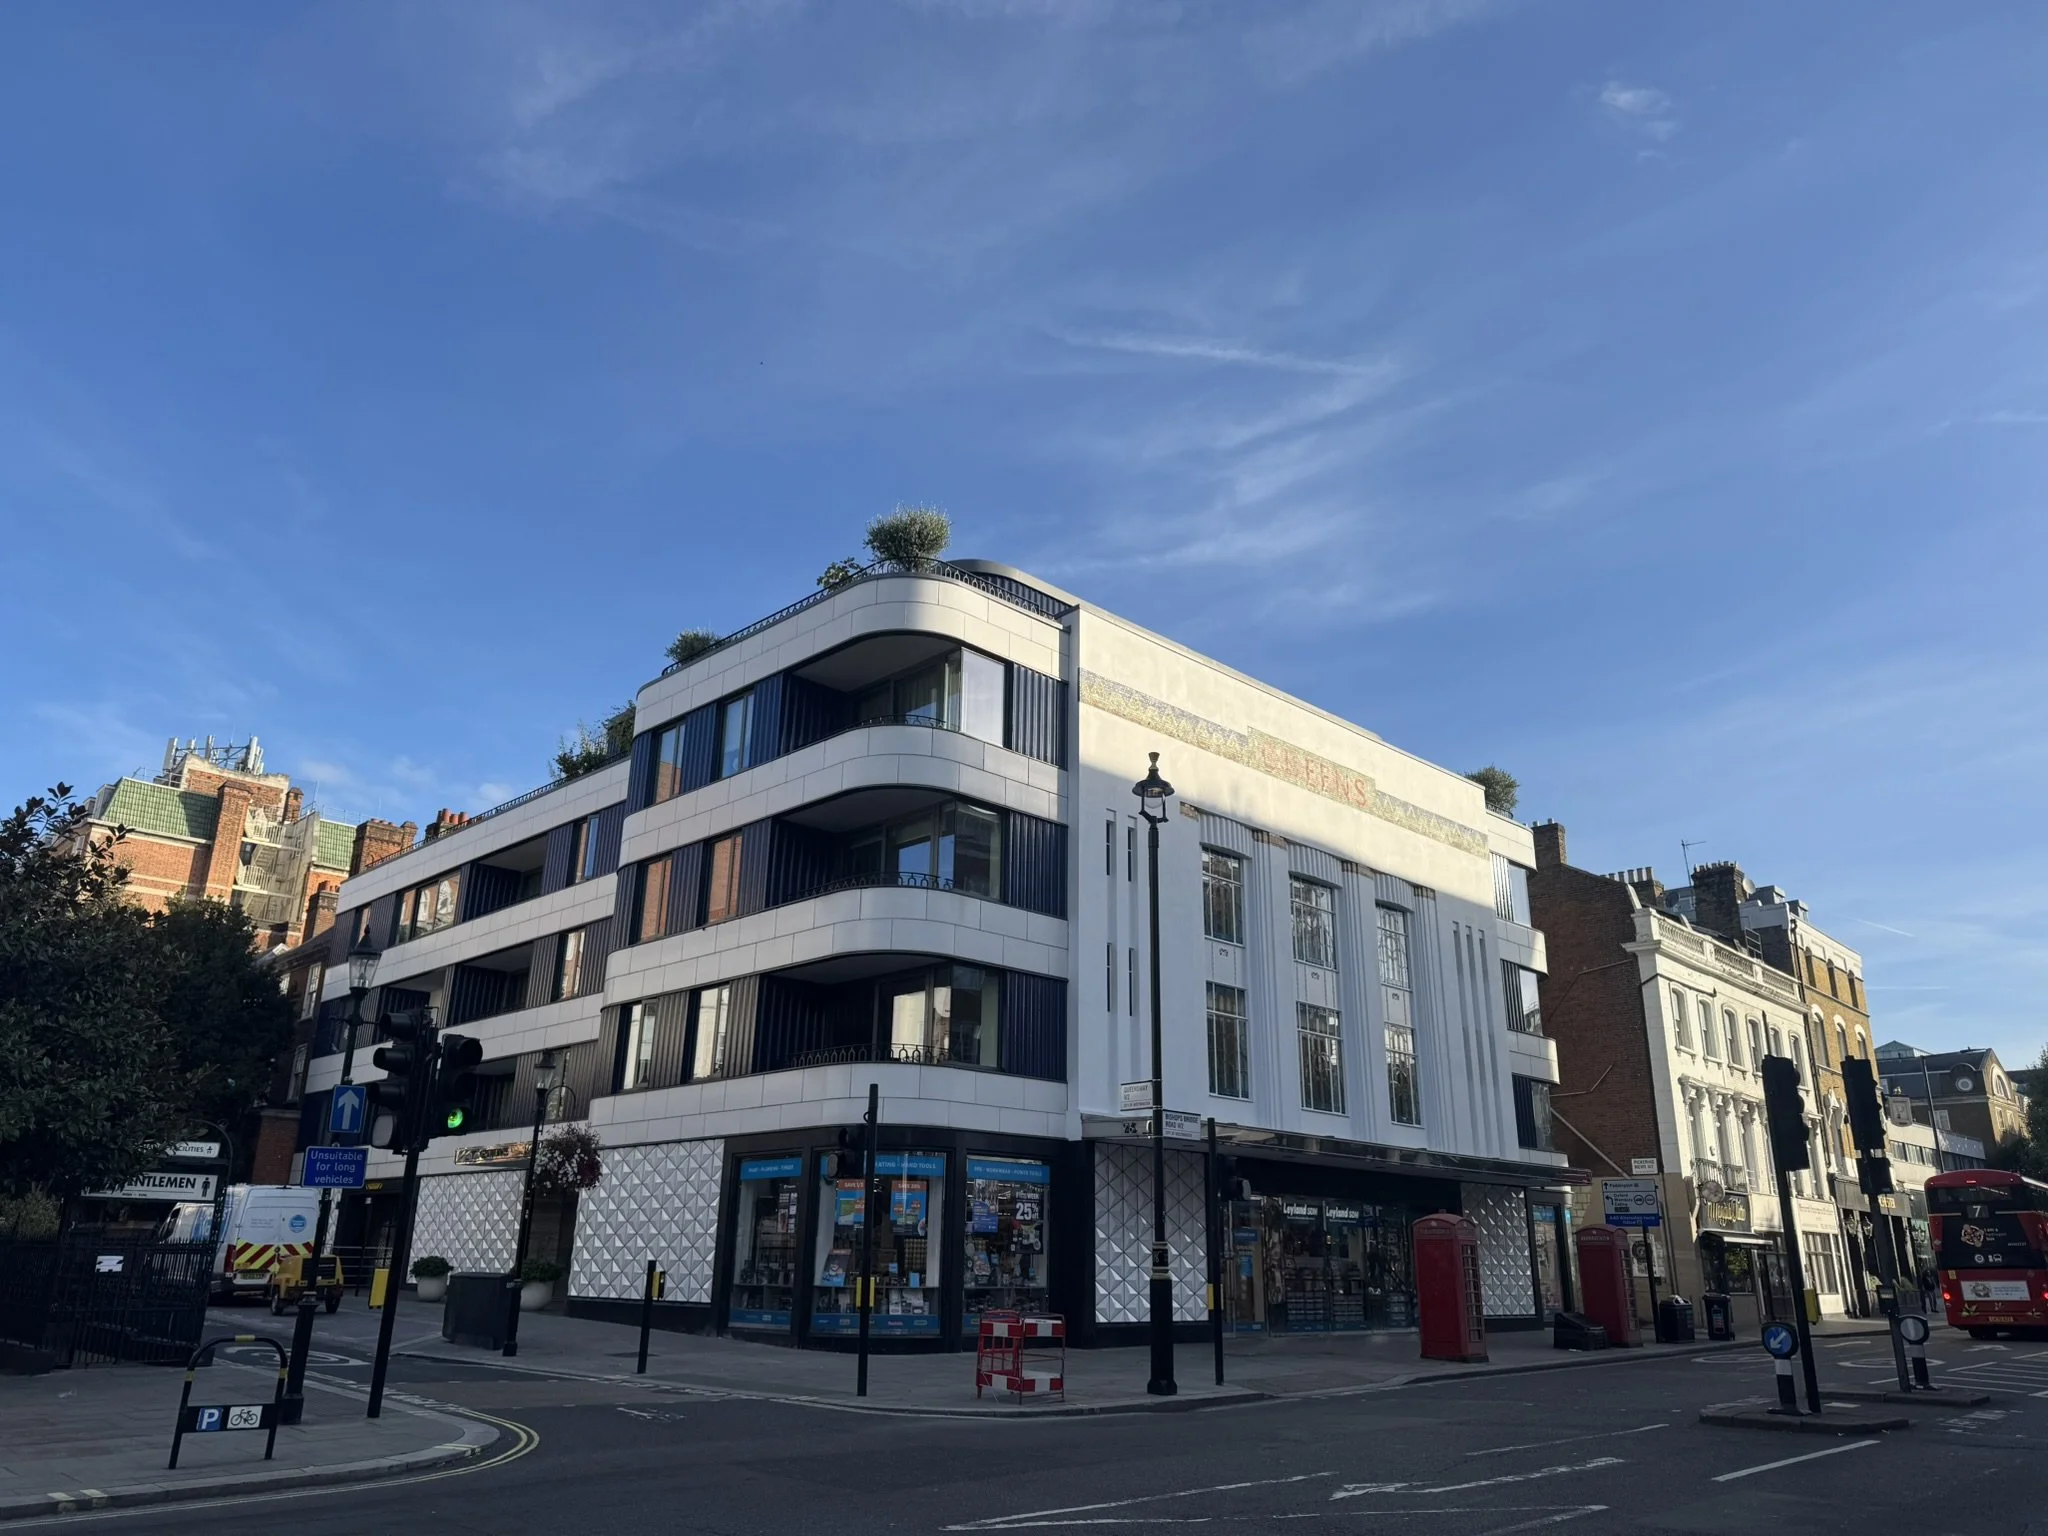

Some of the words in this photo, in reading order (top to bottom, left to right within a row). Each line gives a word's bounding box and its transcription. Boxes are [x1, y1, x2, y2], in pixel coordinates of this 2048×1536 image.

[1260, 741, 1367, 808] QUEENS
[311, 1151, 363, 1160] Unsuitable
[316, 1161, 330, 1171] for
[334, 1162, 356, 1172] long
[127, 1175, 196, 1189] ENTLEMEN
[314, 1175, 354, 1184] vehicles
[1283, 1202, 1306, 1217] Leyland
[1326, 1205, 1348, 1219] Leyland
[1973, 1205, 1982, 1218] 7
[202, 1408, 219, 1430] P
